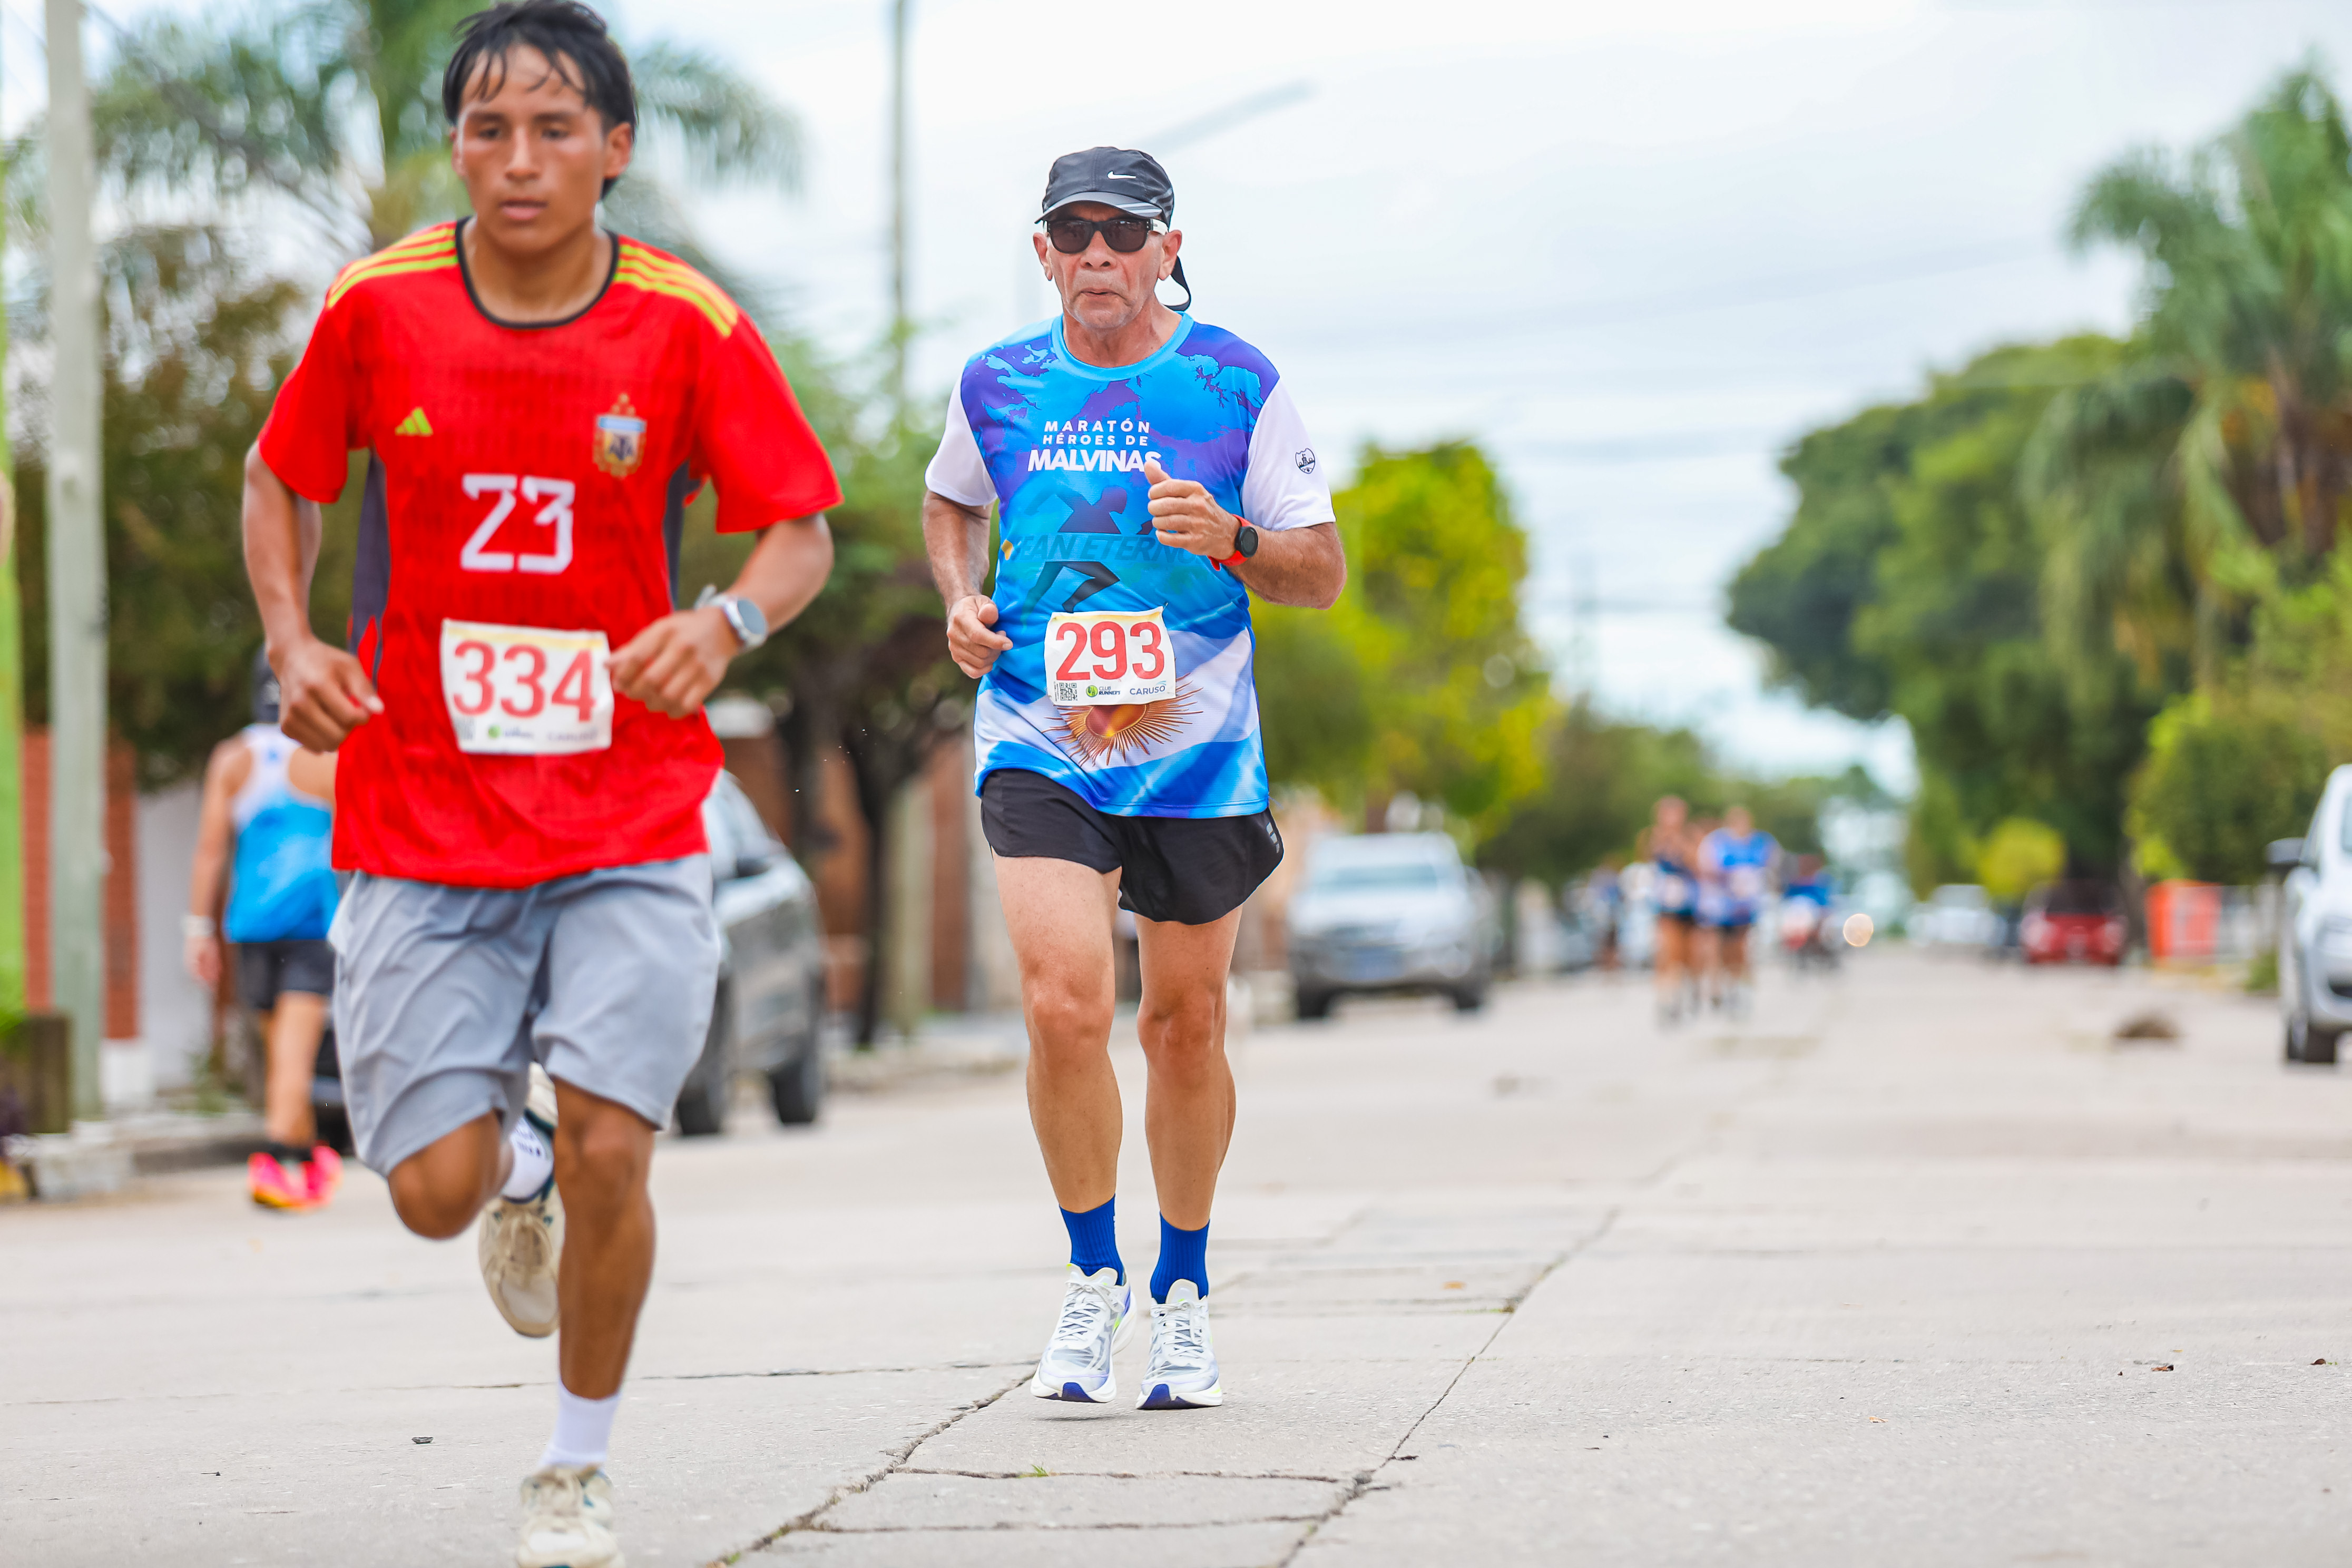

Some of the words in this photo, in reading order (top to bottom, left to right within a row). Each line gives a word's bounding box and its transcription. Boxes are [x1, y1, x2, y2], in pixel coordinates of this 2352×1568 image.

[1044, 418, 1150, 433] MARATÓN
[1043, 433, 1116, 446] HÉROES
[1125, 436, 1148, 446] DE
[1027, 448, 1162, 473] MALVINAS
[460, 473, 575, 574] 23
[1056, 621, 1164, 680] 293
[453, 638, 596, 722] 334
[1130, 685, 1165, 695] CARUSO
